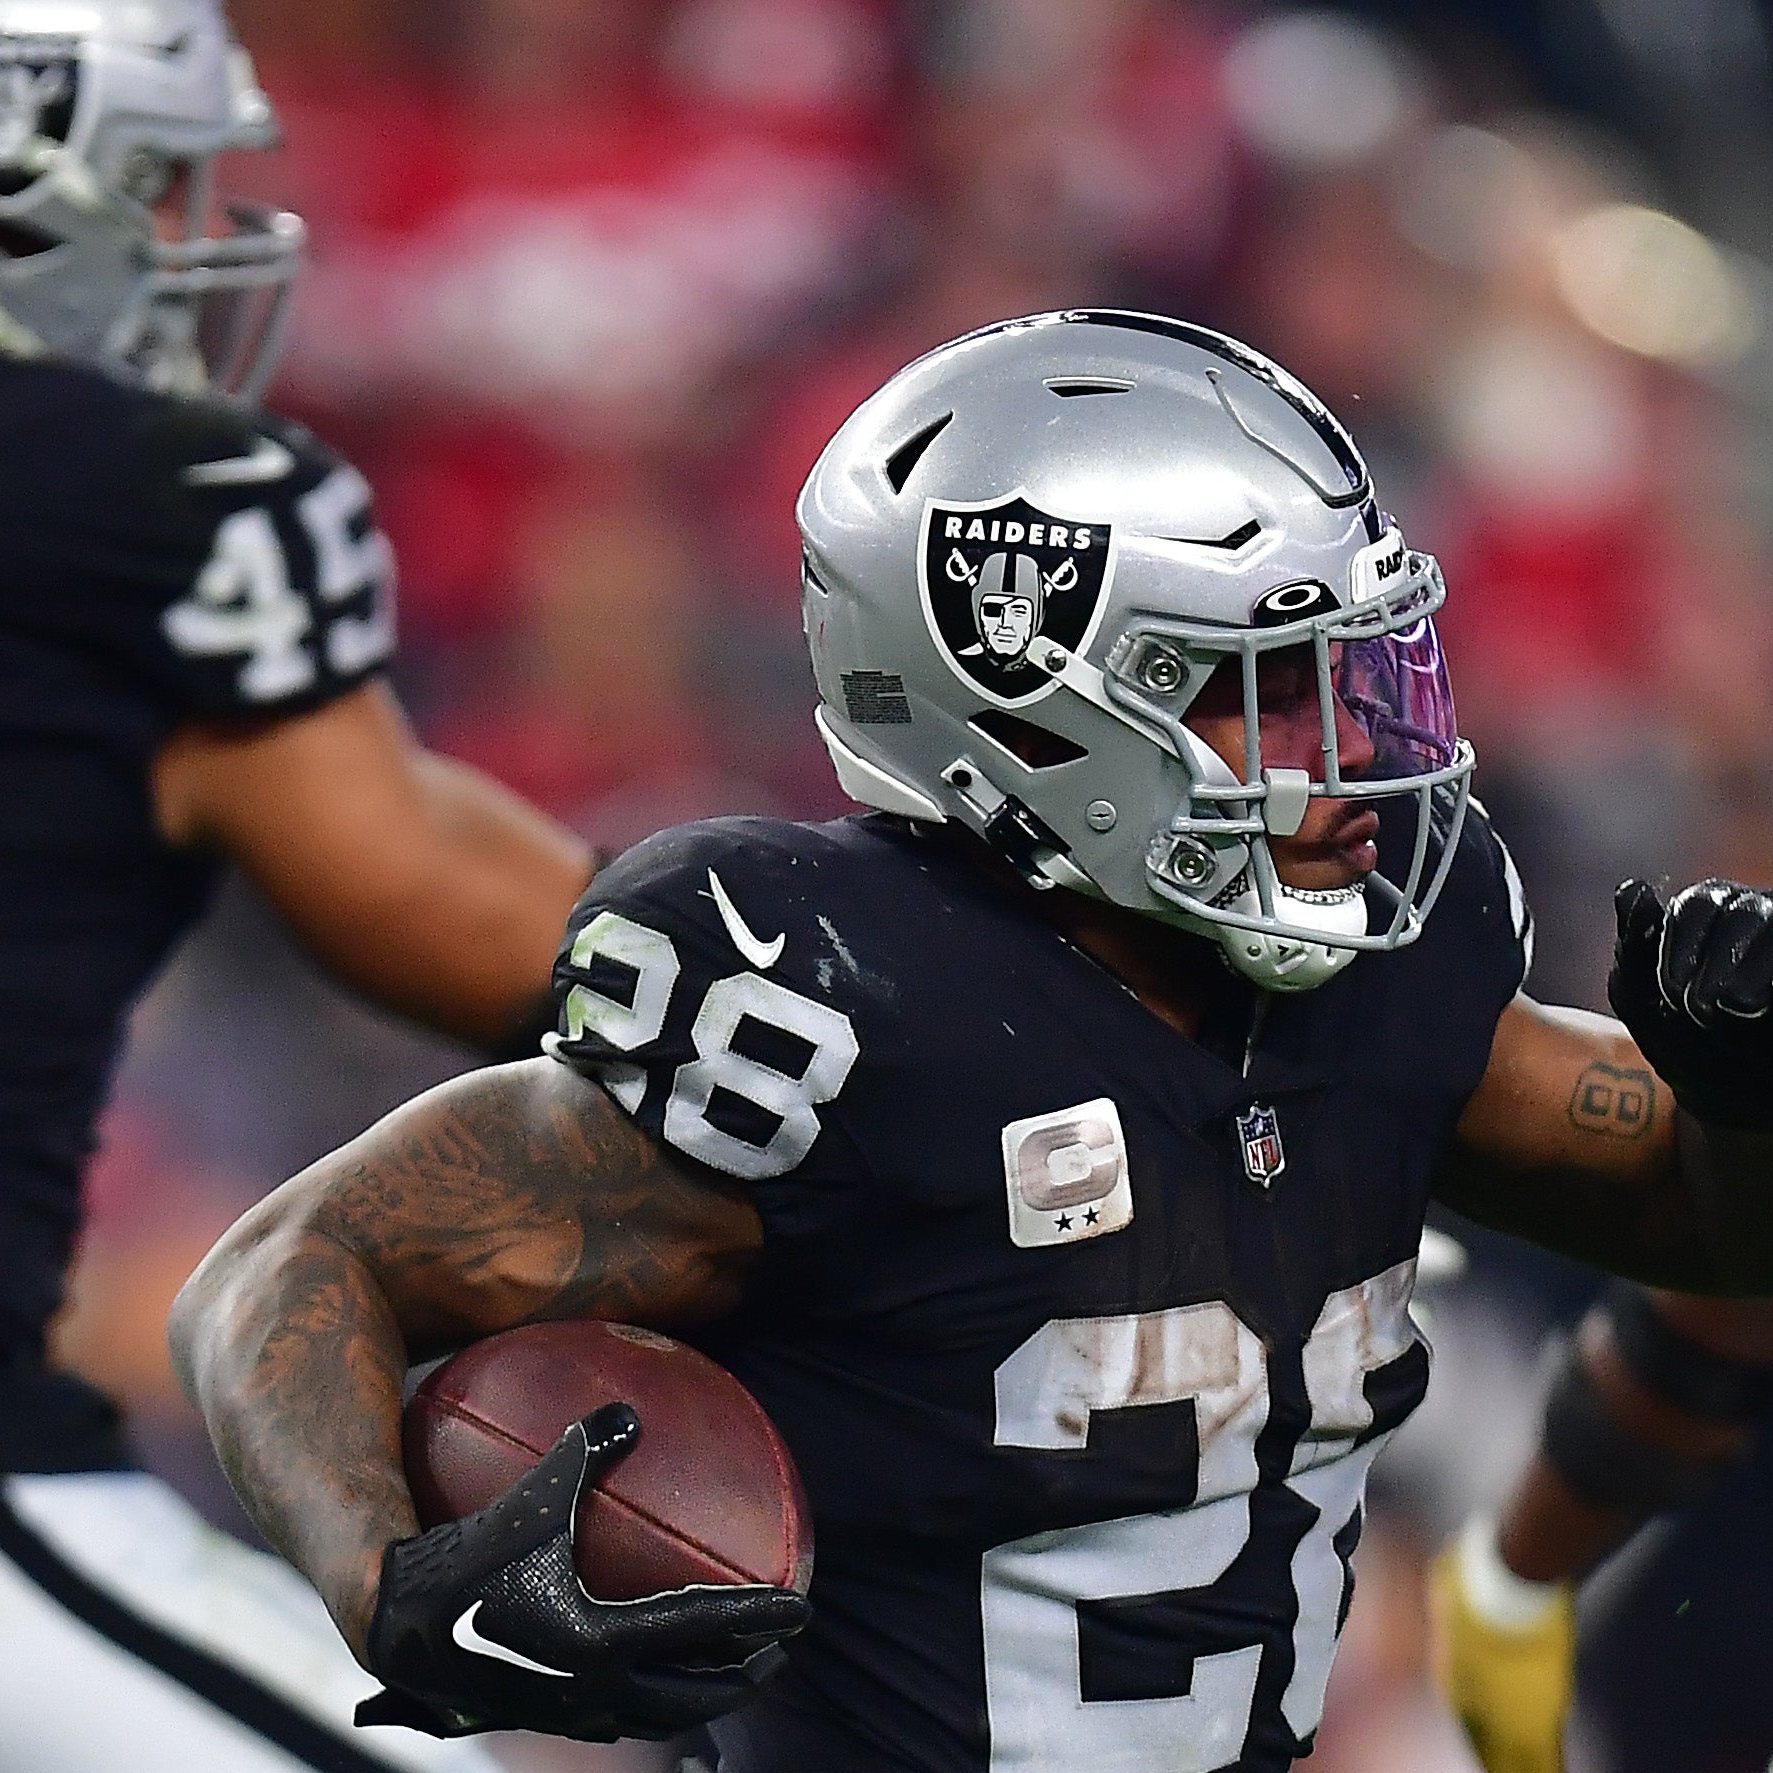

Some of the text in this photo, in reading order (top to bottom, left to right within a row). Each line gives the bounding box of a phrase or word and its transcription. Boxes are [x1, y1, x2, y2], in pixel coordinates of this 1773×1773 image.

[161, 460, 399, 703] 45
[944, 516, 1092, 550] RAIDERS
[542, 910, 860, 1181] 28
[1018, 1118, 1119, 1212] C
